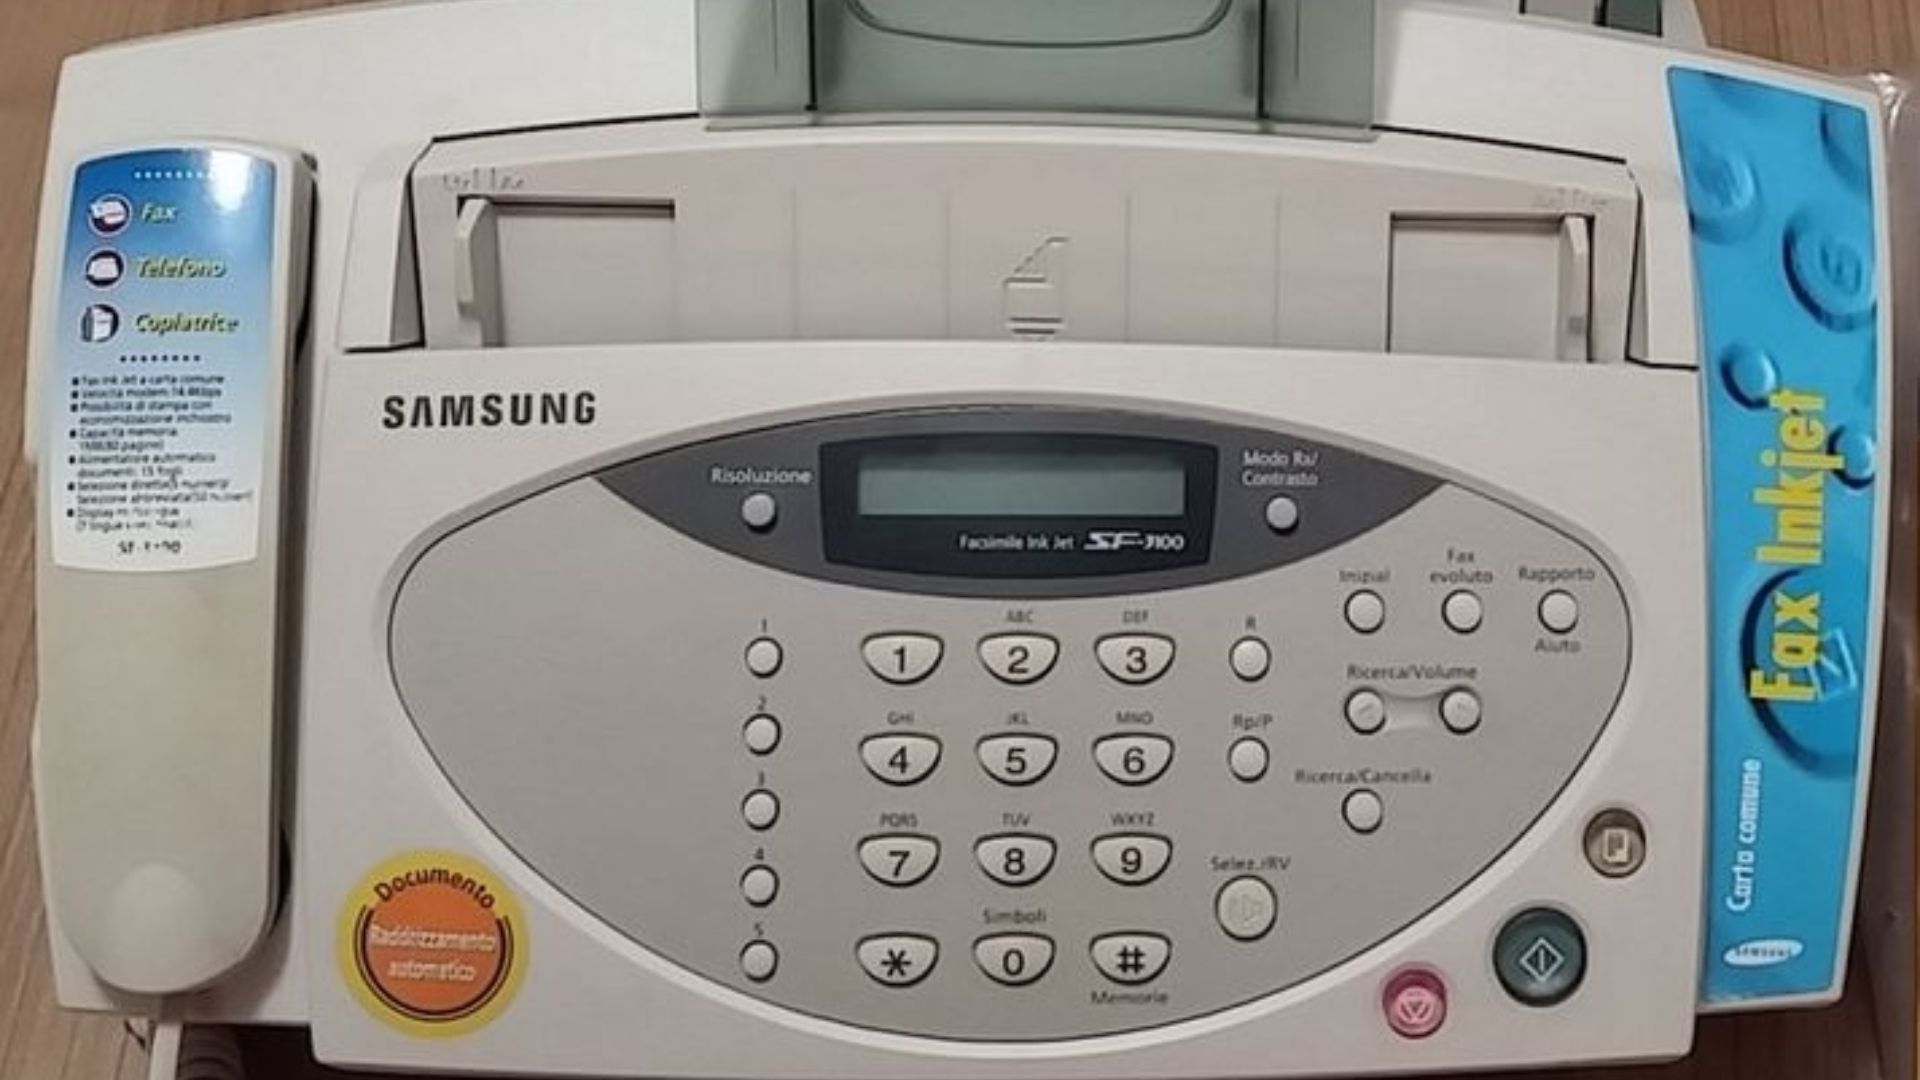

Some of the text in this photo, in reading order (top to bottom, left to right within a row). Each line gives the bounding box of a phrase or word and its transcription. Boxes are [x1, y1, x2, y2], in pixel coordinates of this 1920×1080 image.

[140, 203, 178, 224] Fax
[136, 257, 227, 279] Telefono
[382, 391, 597, 430] SAMSUNG
[1243, 449, 1290, 467] Modo
[711, 467, 813, 484] Risoluzione
[1241, 469, 1319, 487] Contrasto
[959, 534, 1024, 551] Facsimile
[1026, 534, 1050, 551] Ink
[1052, 534, 1075, 551] Jet
[1750, 388, 1845, 701] Fax Inkjet
[1447, 549, 1475, 564] Fax
[1430, 568, 1494, 584] evoluto
[1518, 566, 1596, 584] Rapporto
[1006, 610, 1034, 624] ABC
[1123, 610, 1150, 624] DEF
[1245, 616, 1257, 631] R
[1534, 639, 1581, 655] Aiuto
[892, 645, 907, 674] 1
[1007, 646, 1030, 675] 2
[1126, 646, 1148, 674] 3
[1346, 664, 1477, 681] Ricerca/Volume
[1116, 712, 1154, 726] MNO
[887, 746, 909, 774] 4
[1004, 747, 1027, 775] 5
[1123, 747, 1146, 775] 6
[1295, 767, 1432, 784] Ricerca/Cancella
[1726, 758, 1762, 912] Carta comune
[888, 850, 910, 877] 7
[1003, 847, 1025, 875] 8
[1120, 847, 1143, 875] 9
[374, 867, 496, 909] Documento
[983, 908, 1047, 925] Simboli
[1002, 948, 1024, 976] 0
[1090, 991, 1169, 1006] Memorie
